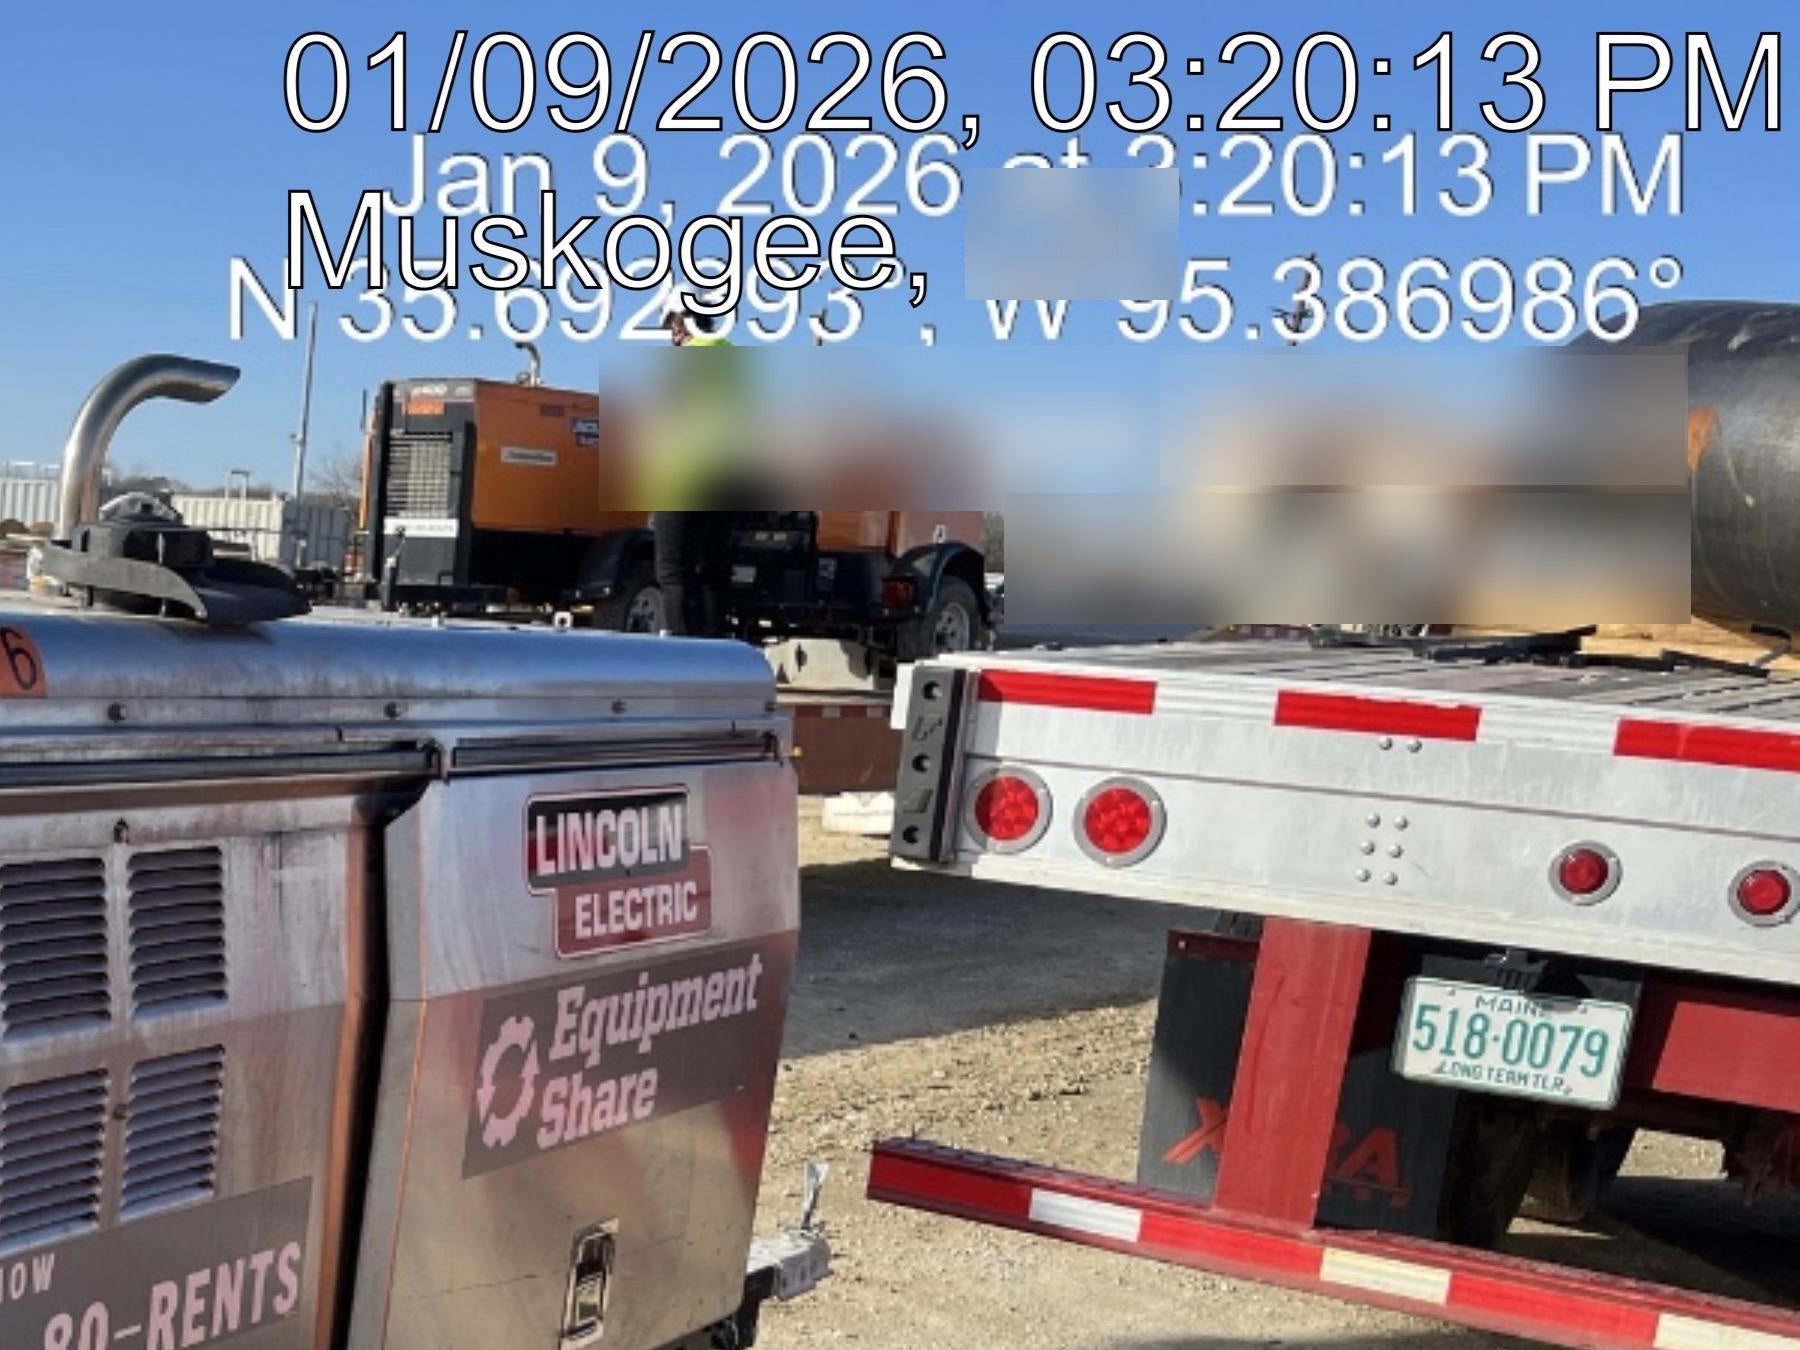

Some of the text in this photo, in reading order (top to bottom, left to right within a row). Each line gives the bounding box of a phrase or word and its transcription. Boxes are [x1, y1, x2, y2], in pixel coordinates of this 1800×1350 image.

[536, 804, 683, 877] LINCOLN
[575, 881, 698, 939] ELECTRIC
[549, 953, 763, 1069] Equipment
[536, 1067, 659, 1151] Share
[1438, 1061, 1483, 1079] LONG
[1487, 1064, 1529, 1086] TERM
